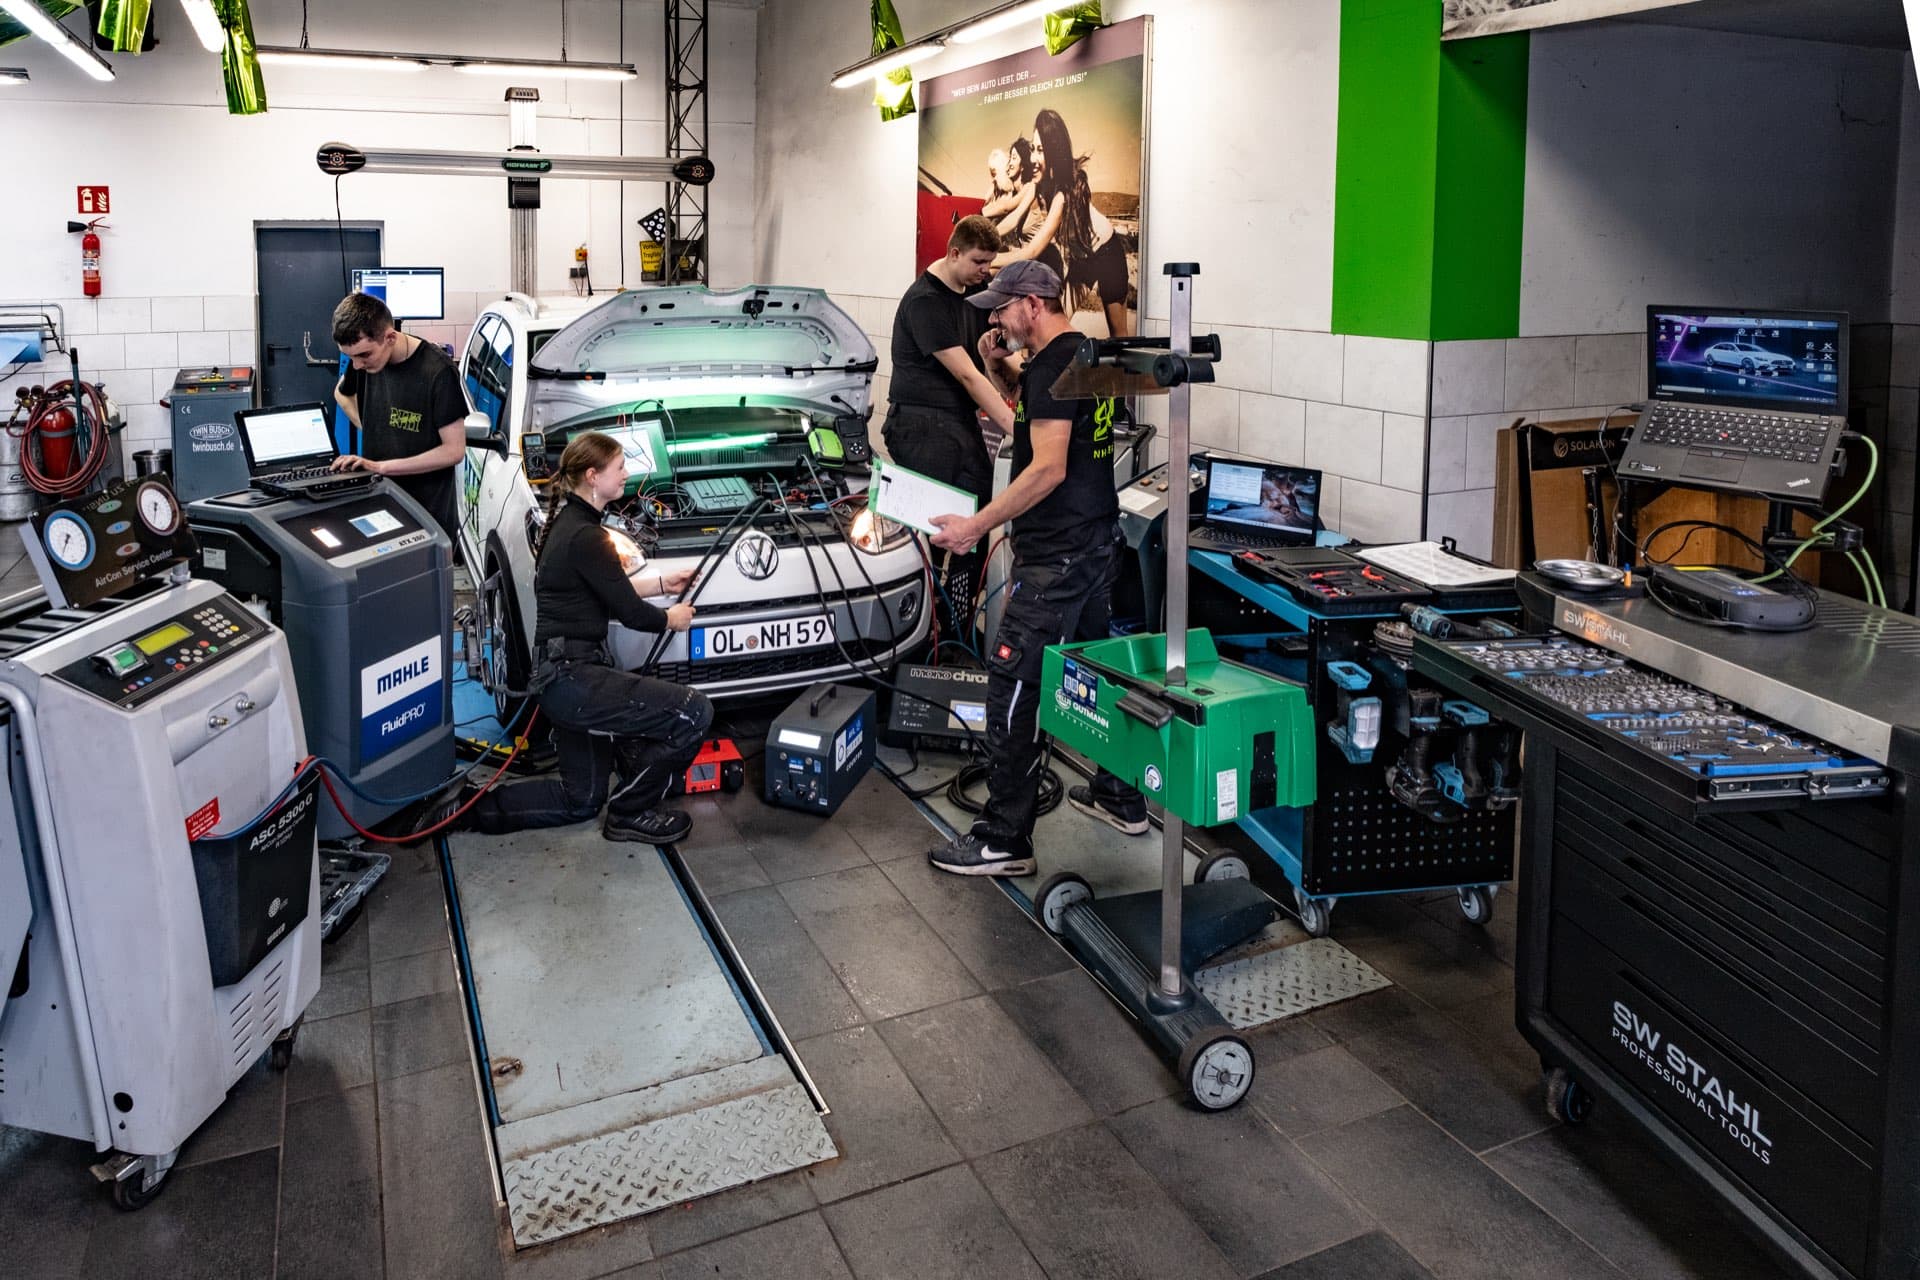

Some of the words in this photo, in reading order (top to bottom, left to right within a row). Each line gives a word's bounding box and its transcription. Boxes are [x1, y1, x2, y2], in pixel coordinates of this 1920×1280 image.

[966, 85, 980, 95] SEIN
[980, 79, 996, 91] AUTO
[997, 74, 1015, 86] LIEBT,
[1016, 70, 1029, 81] DER
[1004, 87, 1029, 100] BESSER
[1029, 80, 1053, 94] GLEICH
[1054, 78, 1065, 88] ZU
[193, 425, 208, 437] TWIN
[209, 425, 230, 434] BUSCH
[192, 440, 235, 453] twinbusch.de
[95, 571, 122, 588] AirCon
[121, 559, 151, 576] Service
[149, 549, 174, 564] Center
[713, 629, 743, 654] OL
[761, 623, 790, 649] NH
[797, 619, 826, 644] 59
[377, 655, 429, 695] MAHLE
[381, 704, 424, 736] FluidPRO
[1072, 702, 1109, 729] GUTMANN
[249, 824, 277, 851] ASC
[1613, 1001, 1661, 1051] SW
[1666, 1042, 1772, 1147] STAHL
[1612, 1026, 1715, 1120] PROFESSIONAL
[1719, 1114, 1770, 1165] TOOLS
